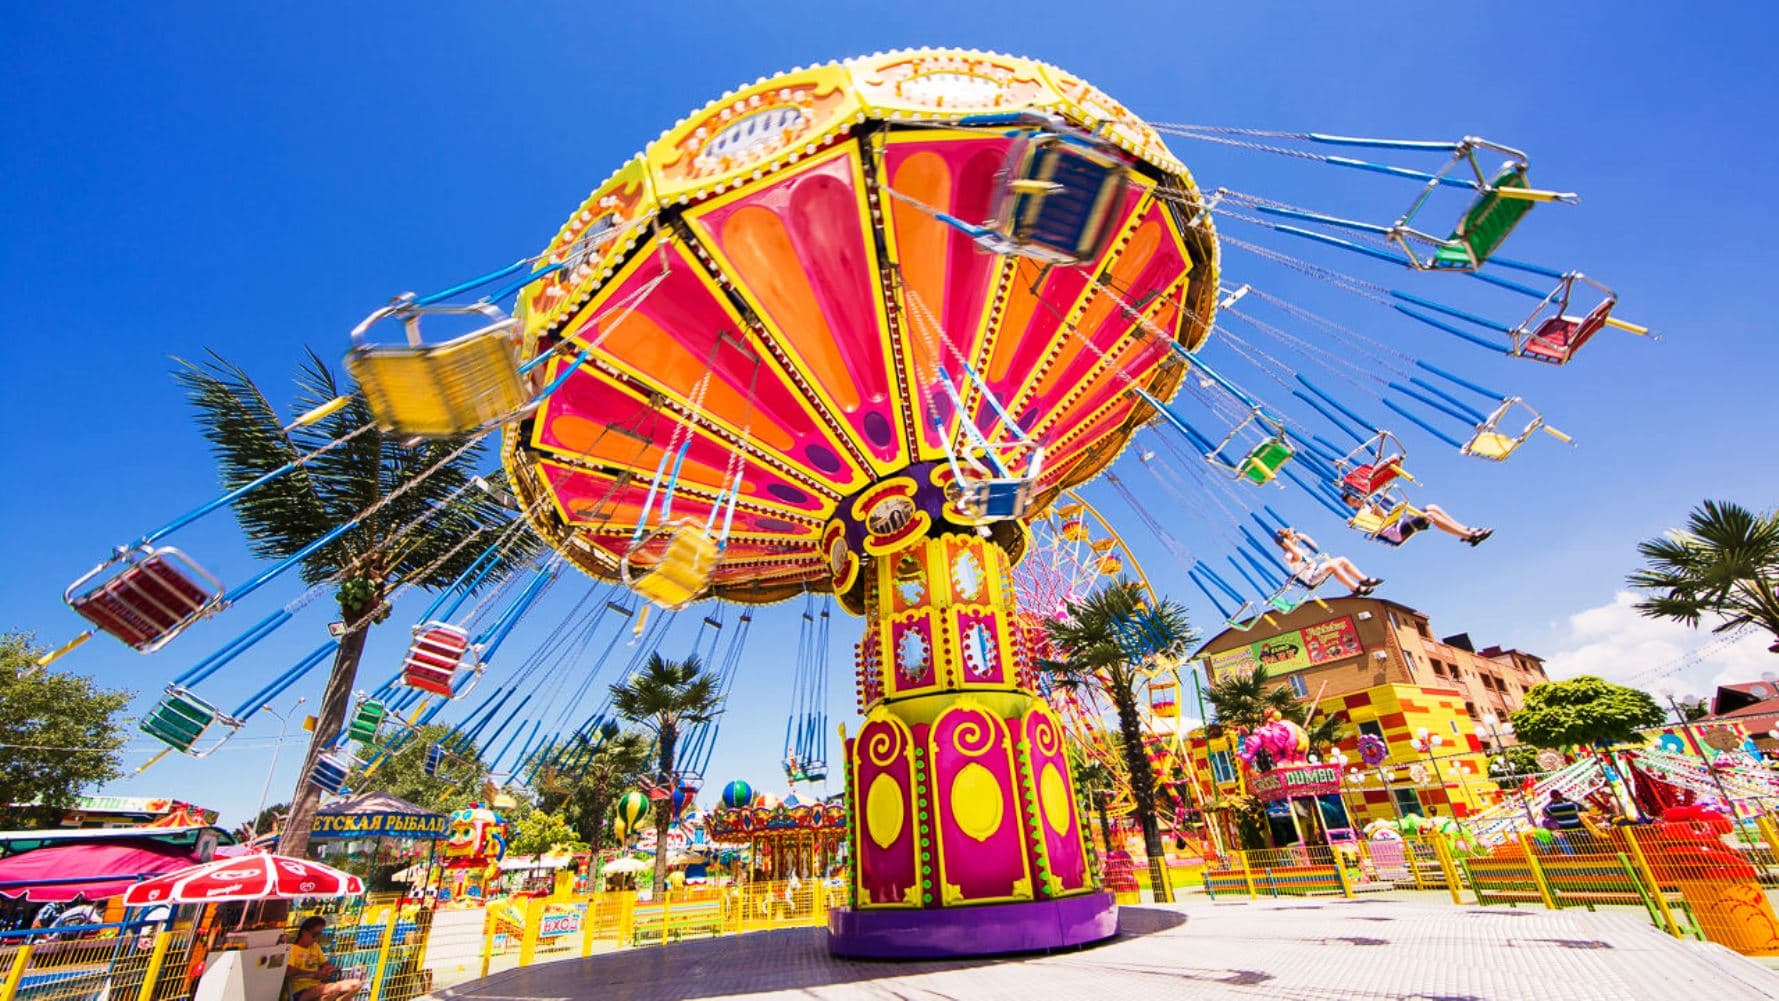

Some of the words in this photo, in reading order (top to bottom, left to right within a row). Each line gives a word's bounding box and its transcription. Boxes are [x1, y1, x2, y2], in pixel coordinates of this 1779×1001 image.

[1285, 768, 1335, 785] DUMBO
[312, 815, 381, 831] ЕТСКАЯ
[544, 918, 578, 932] ВХОД
